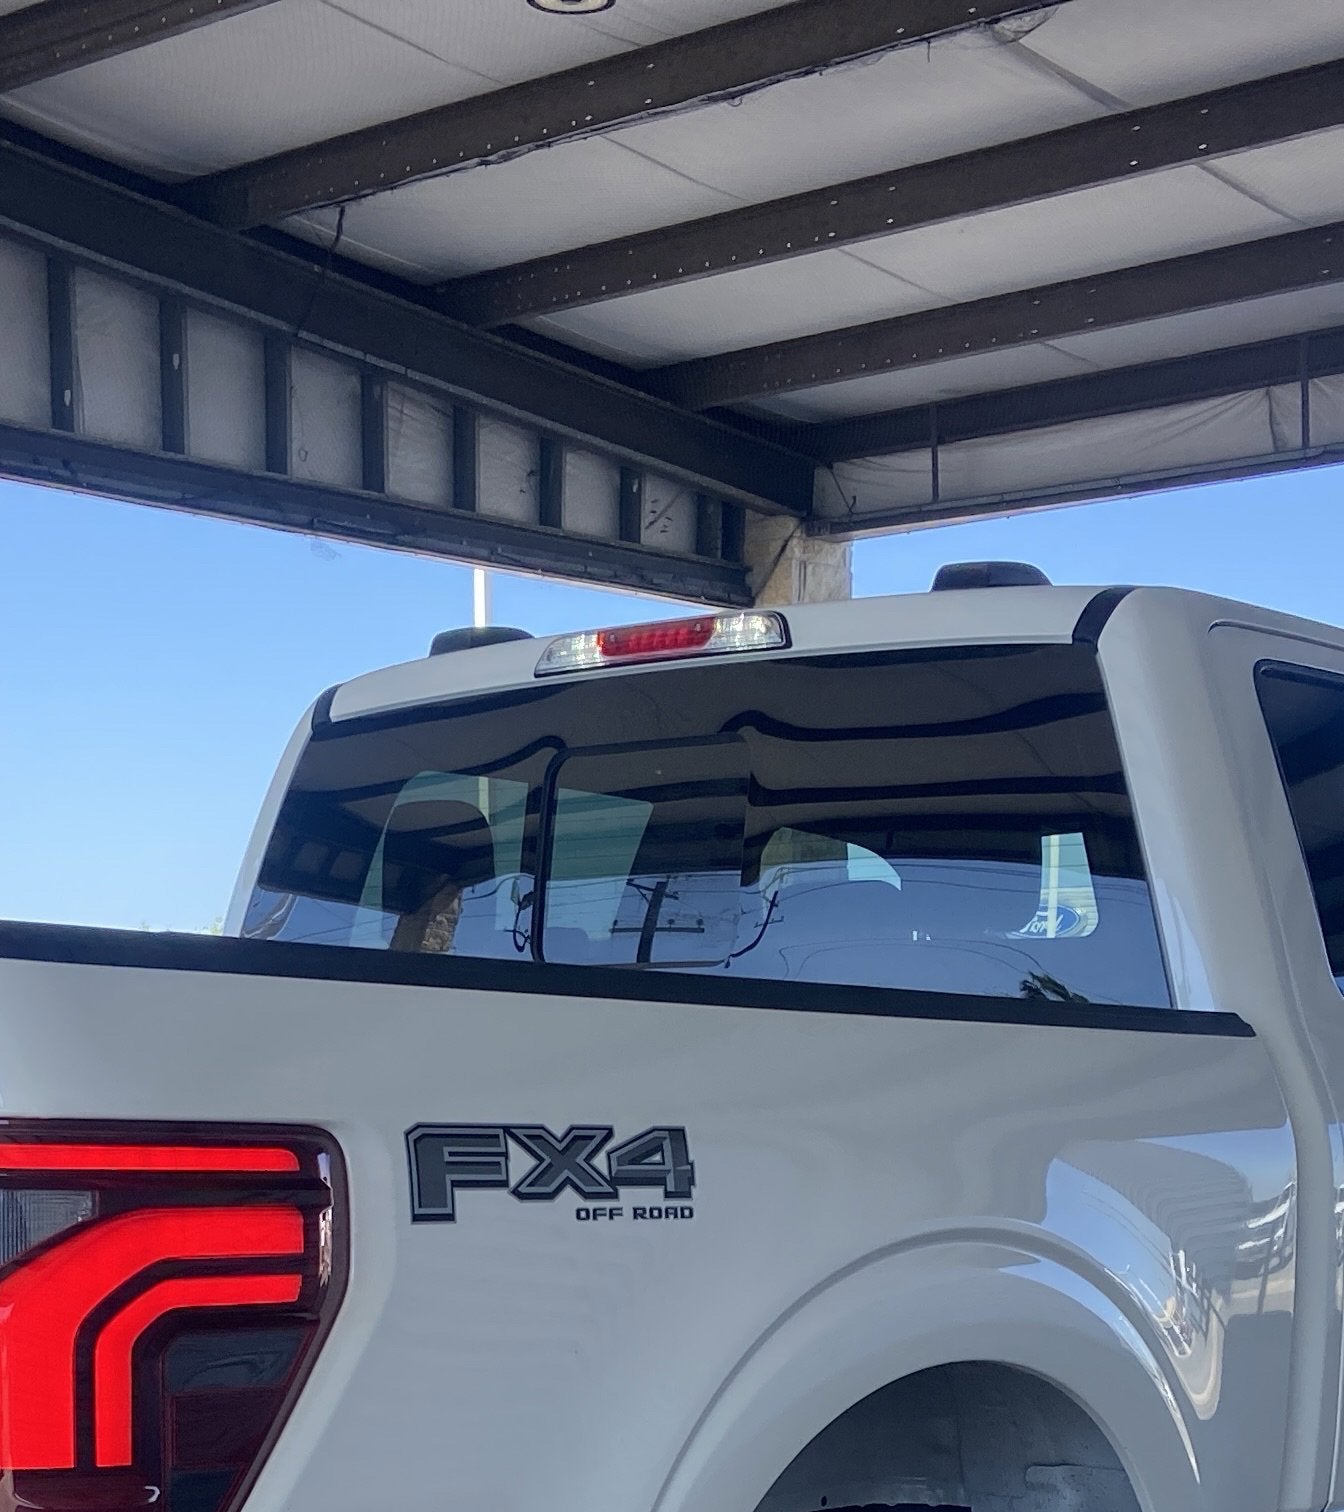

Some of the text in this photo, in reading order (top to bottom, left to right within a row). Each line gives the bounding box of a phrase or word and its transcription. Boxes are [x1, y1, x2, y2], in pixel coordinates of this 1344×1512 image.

[404, 1122, 695, 1224] FX4
[575, 1207, 694, 1221] OFF ROAD
